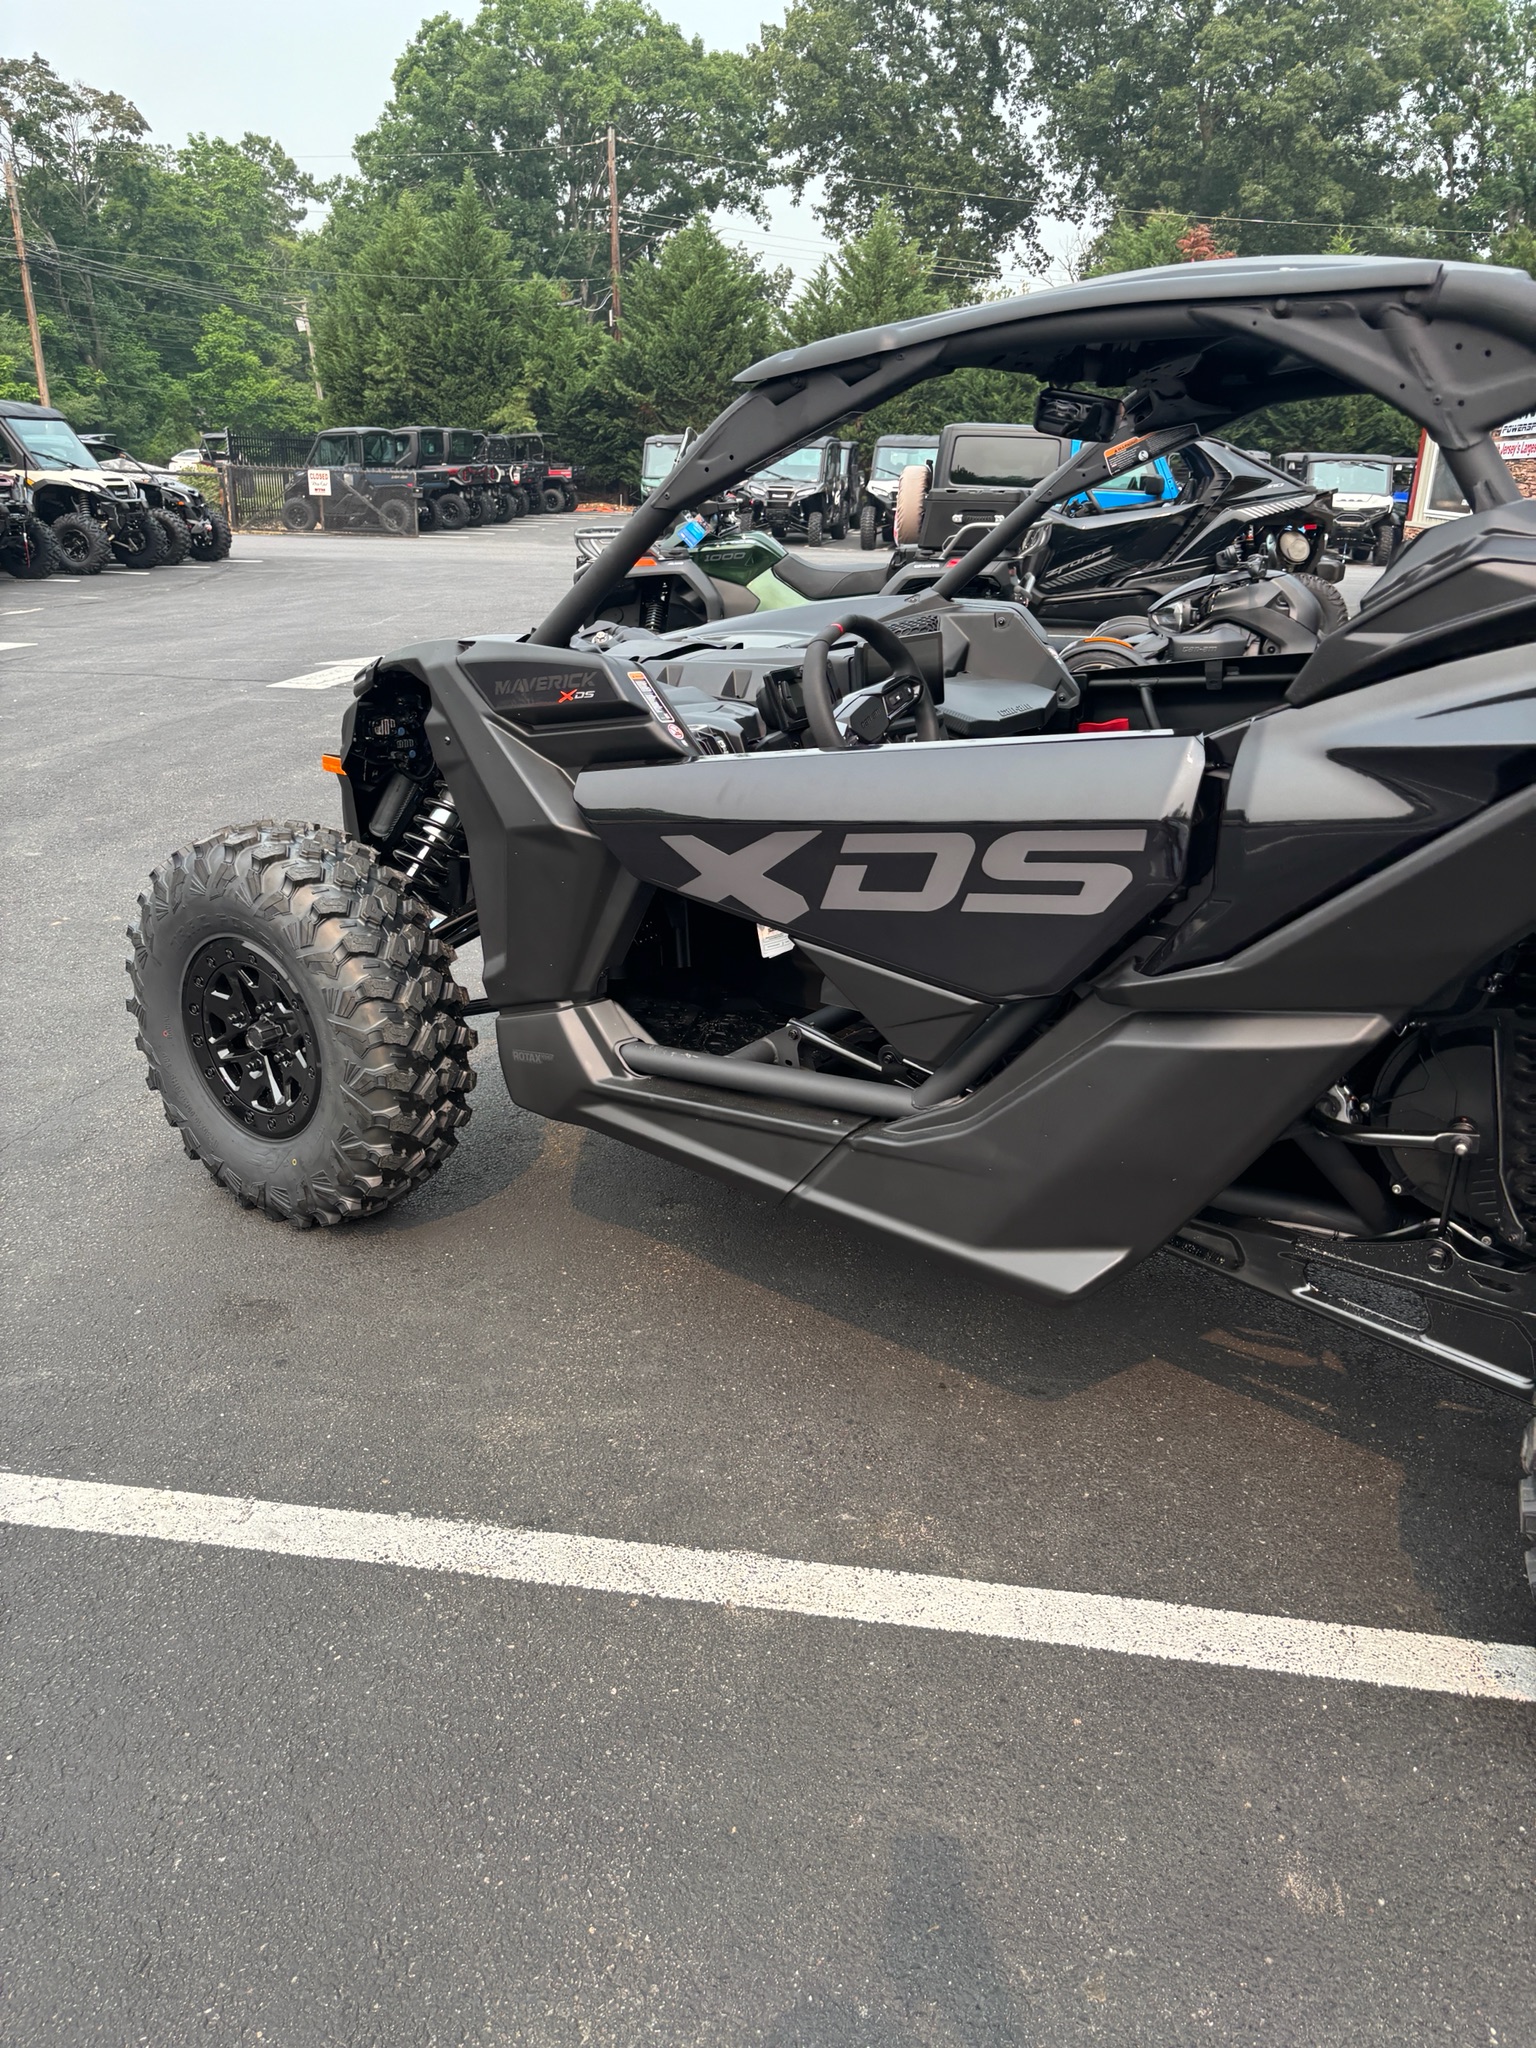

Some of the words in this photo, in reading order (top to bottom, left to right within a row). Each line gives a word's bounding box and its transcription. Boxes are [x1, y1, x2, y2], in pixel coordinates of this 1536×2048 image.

[704, 552, 746, 562] 1000
[495, 671, 598, 696] MAVERICK
[557, 688, 596, 703] XDS
[660, 829, 1148, 924] XDS
[512, 1050, 542, 1064] ROTAX
